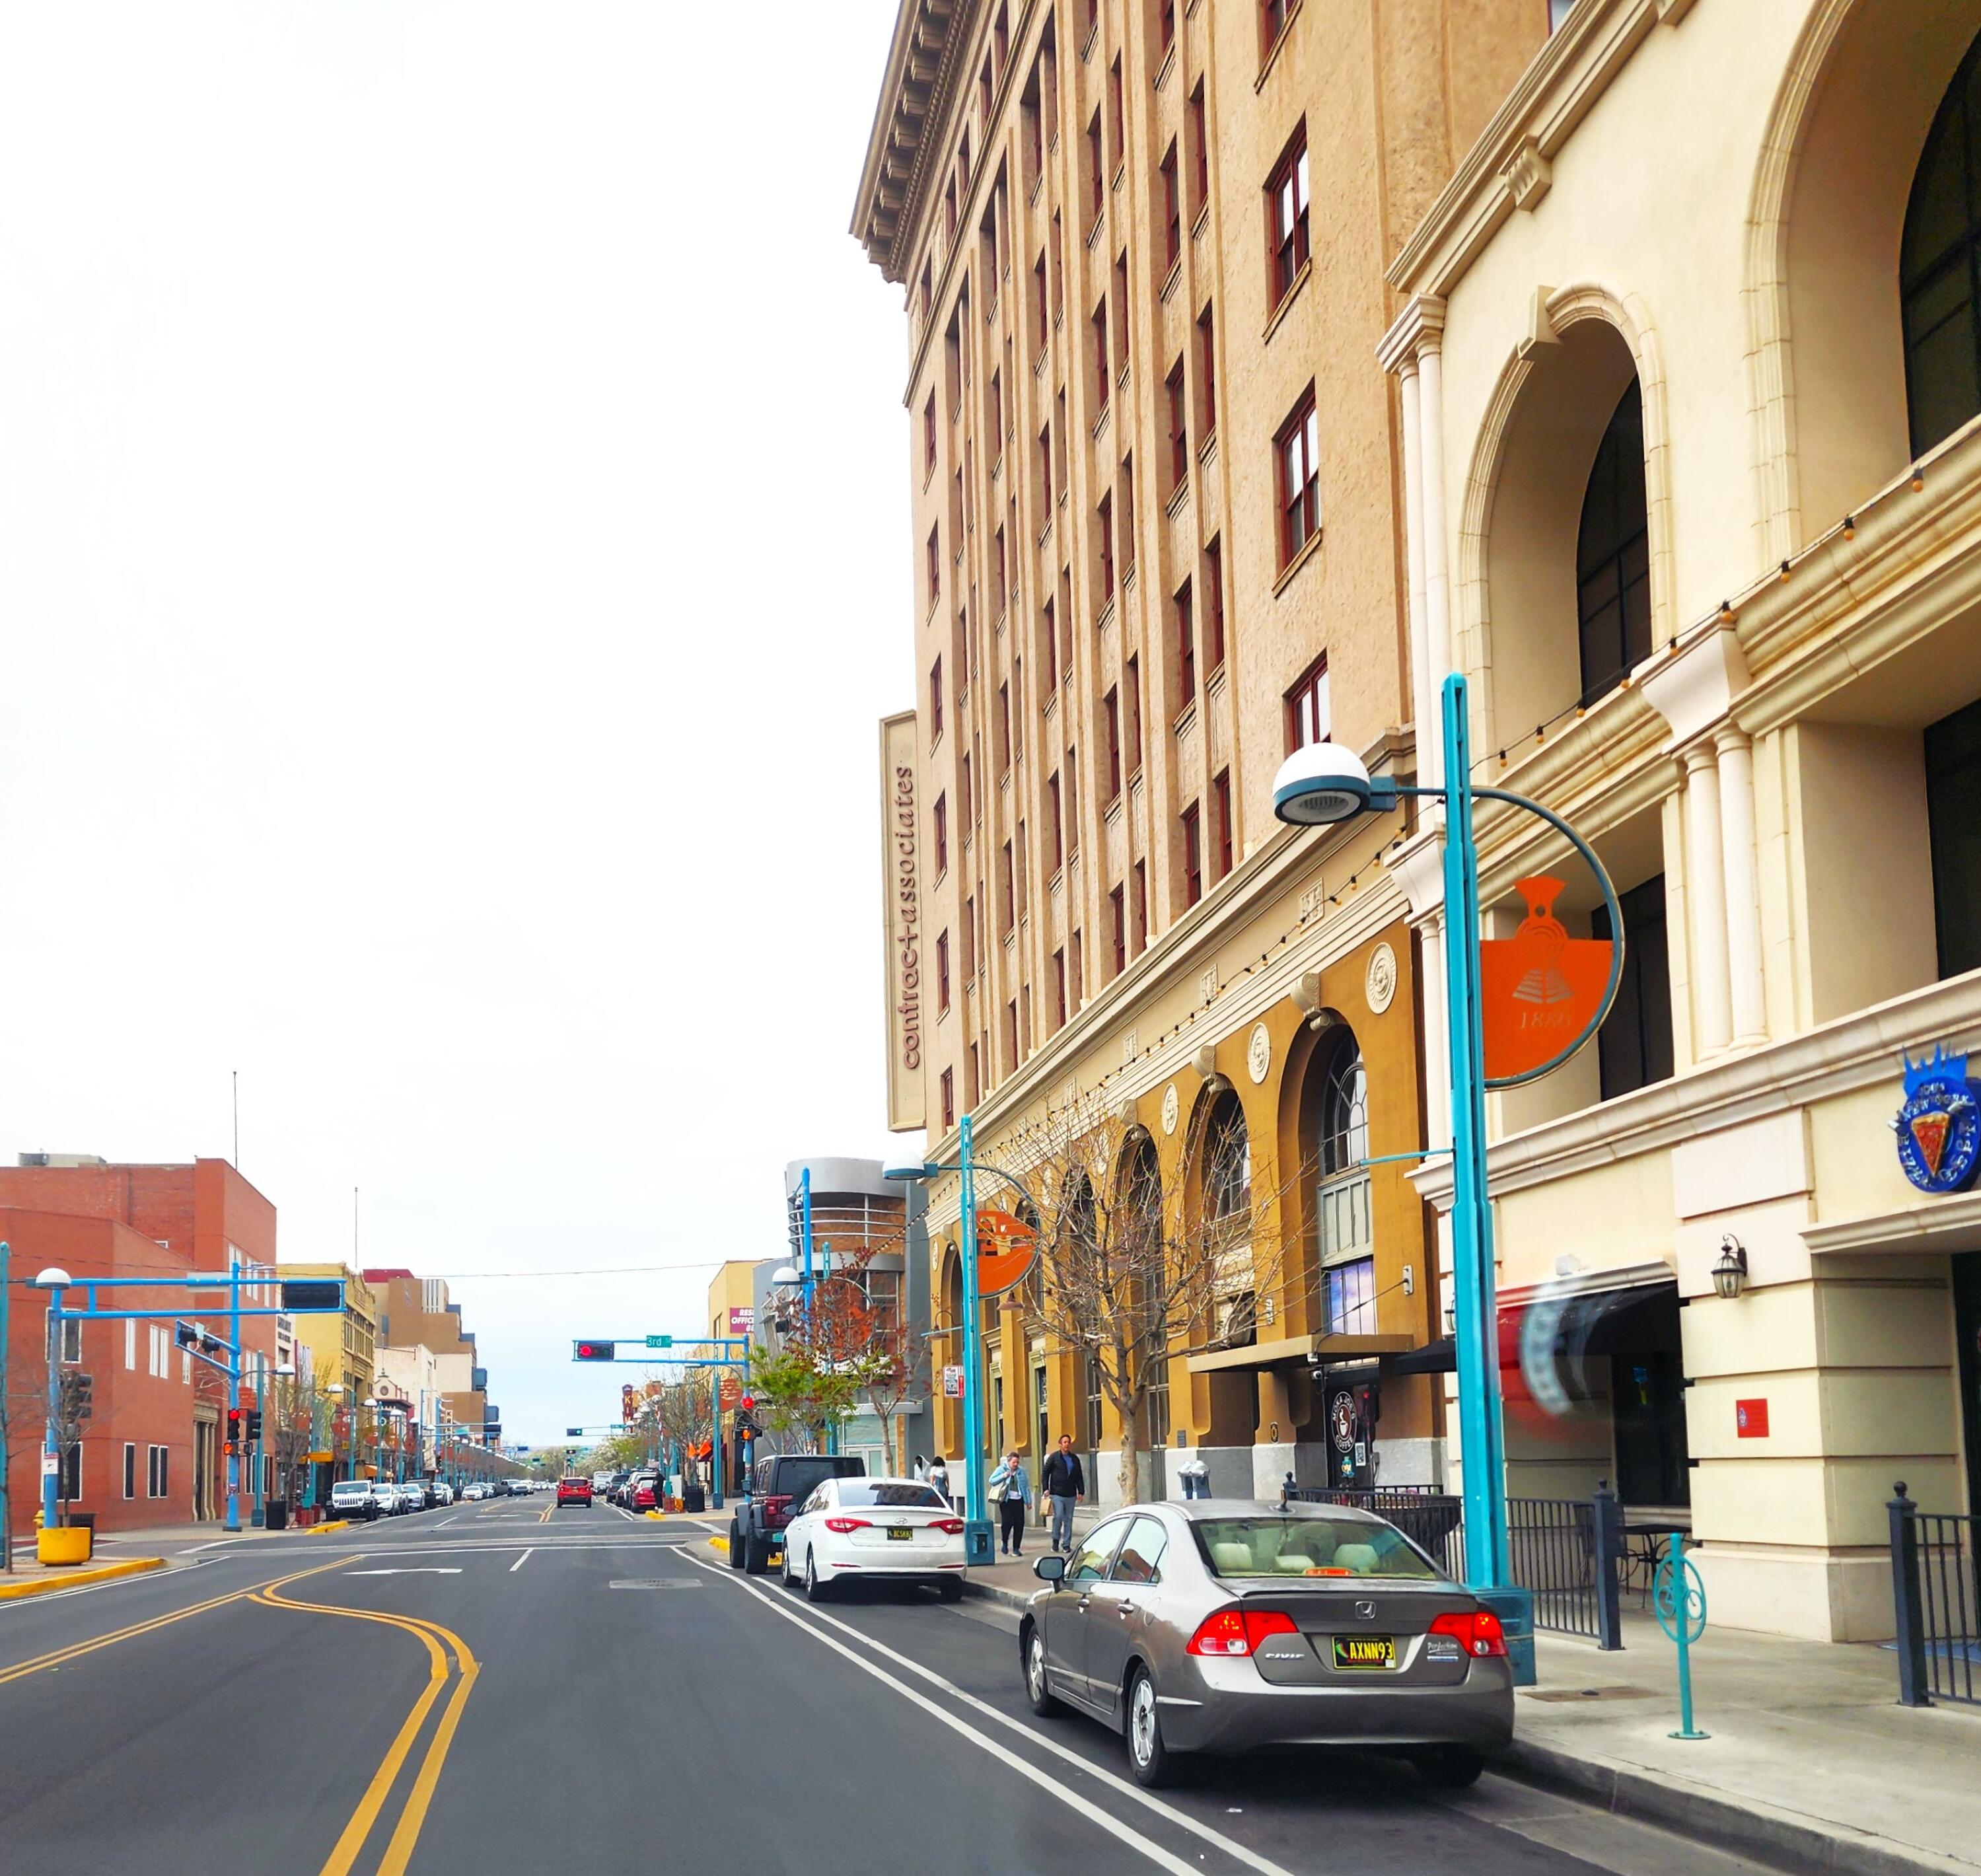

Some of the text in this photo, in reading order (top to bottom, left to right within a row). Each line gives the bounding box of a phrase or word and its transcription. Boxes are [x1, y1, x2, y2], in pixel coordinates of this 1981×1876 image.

[647, 1336, 662, 1346] 3rd
[1336, 1435, 1353, 1450] COFFEE
[1350, 1642, 1393, 1660] AXNN93
